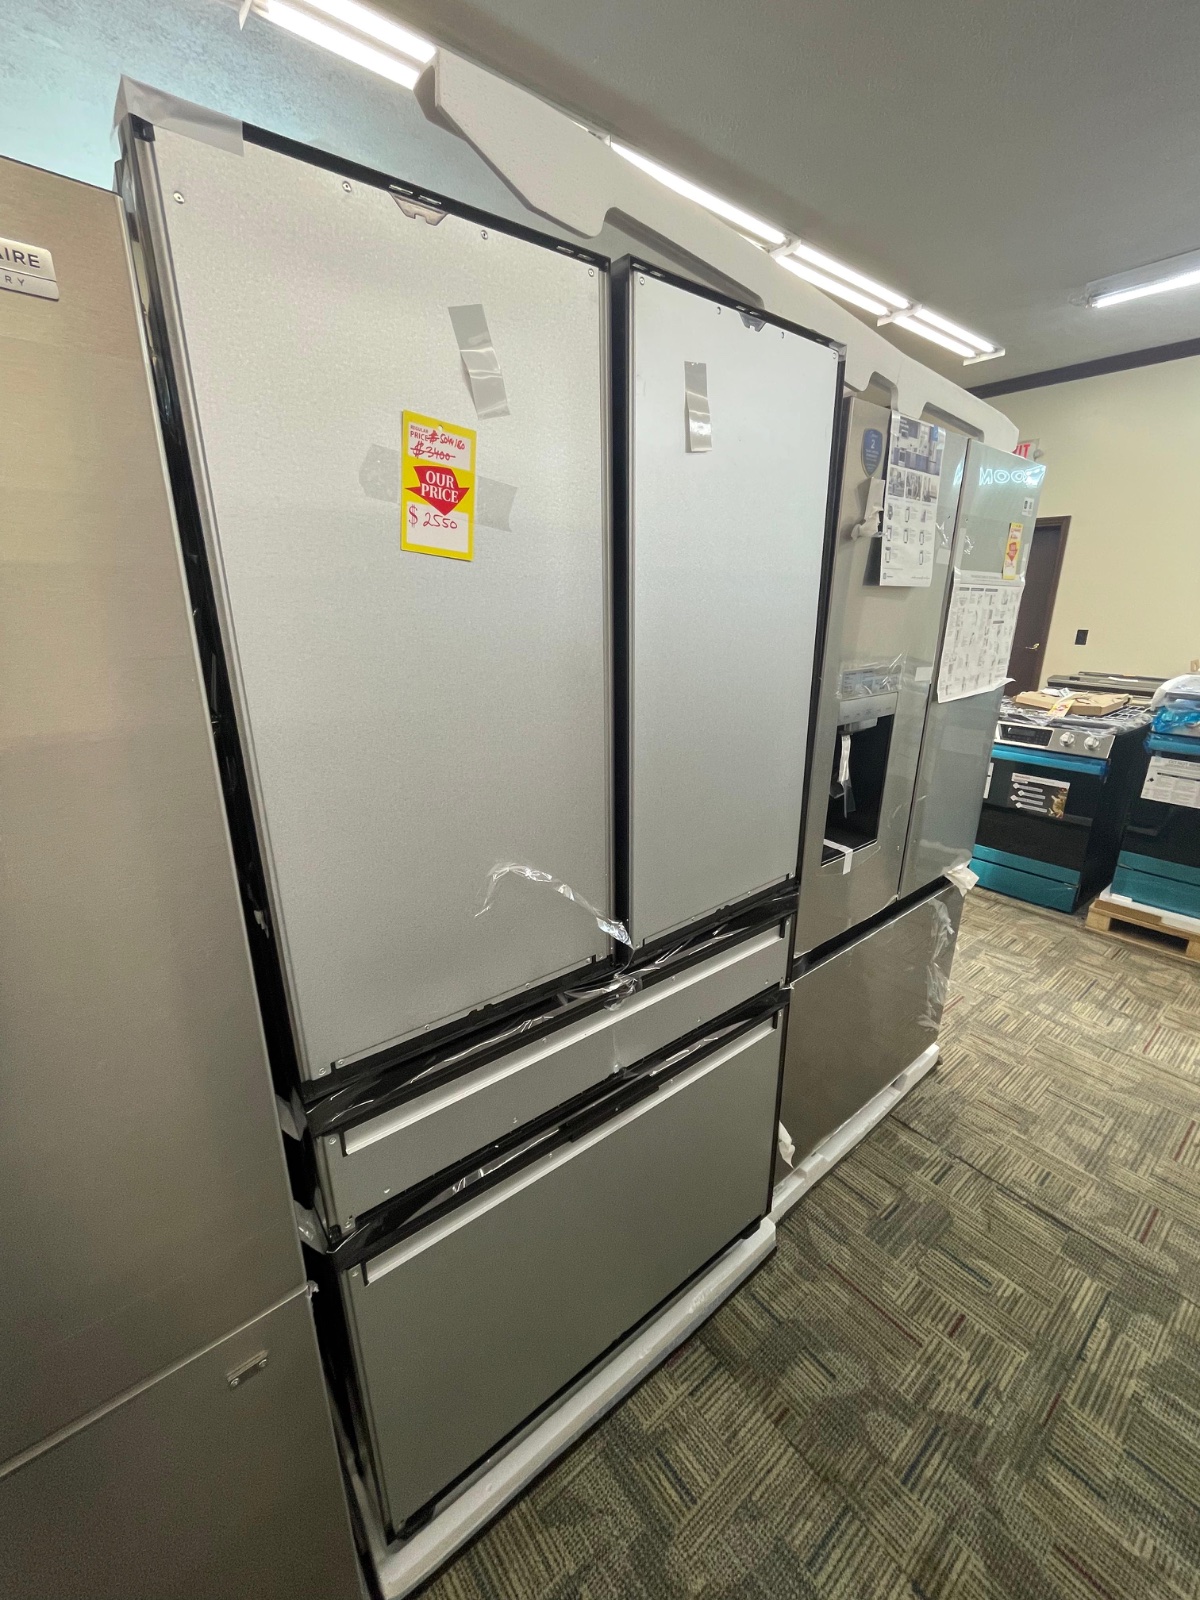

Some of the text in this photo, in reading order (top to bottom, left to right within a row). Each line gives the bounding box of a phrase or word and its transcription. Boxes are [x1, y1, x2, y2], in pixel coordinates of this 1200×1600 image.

[410, 424, 429, 434] REGULAR
[410, 430, 429, 442] PRICE
[425, 470, 455, 489] OUR
[420, 482, 459, 504] PRICE
